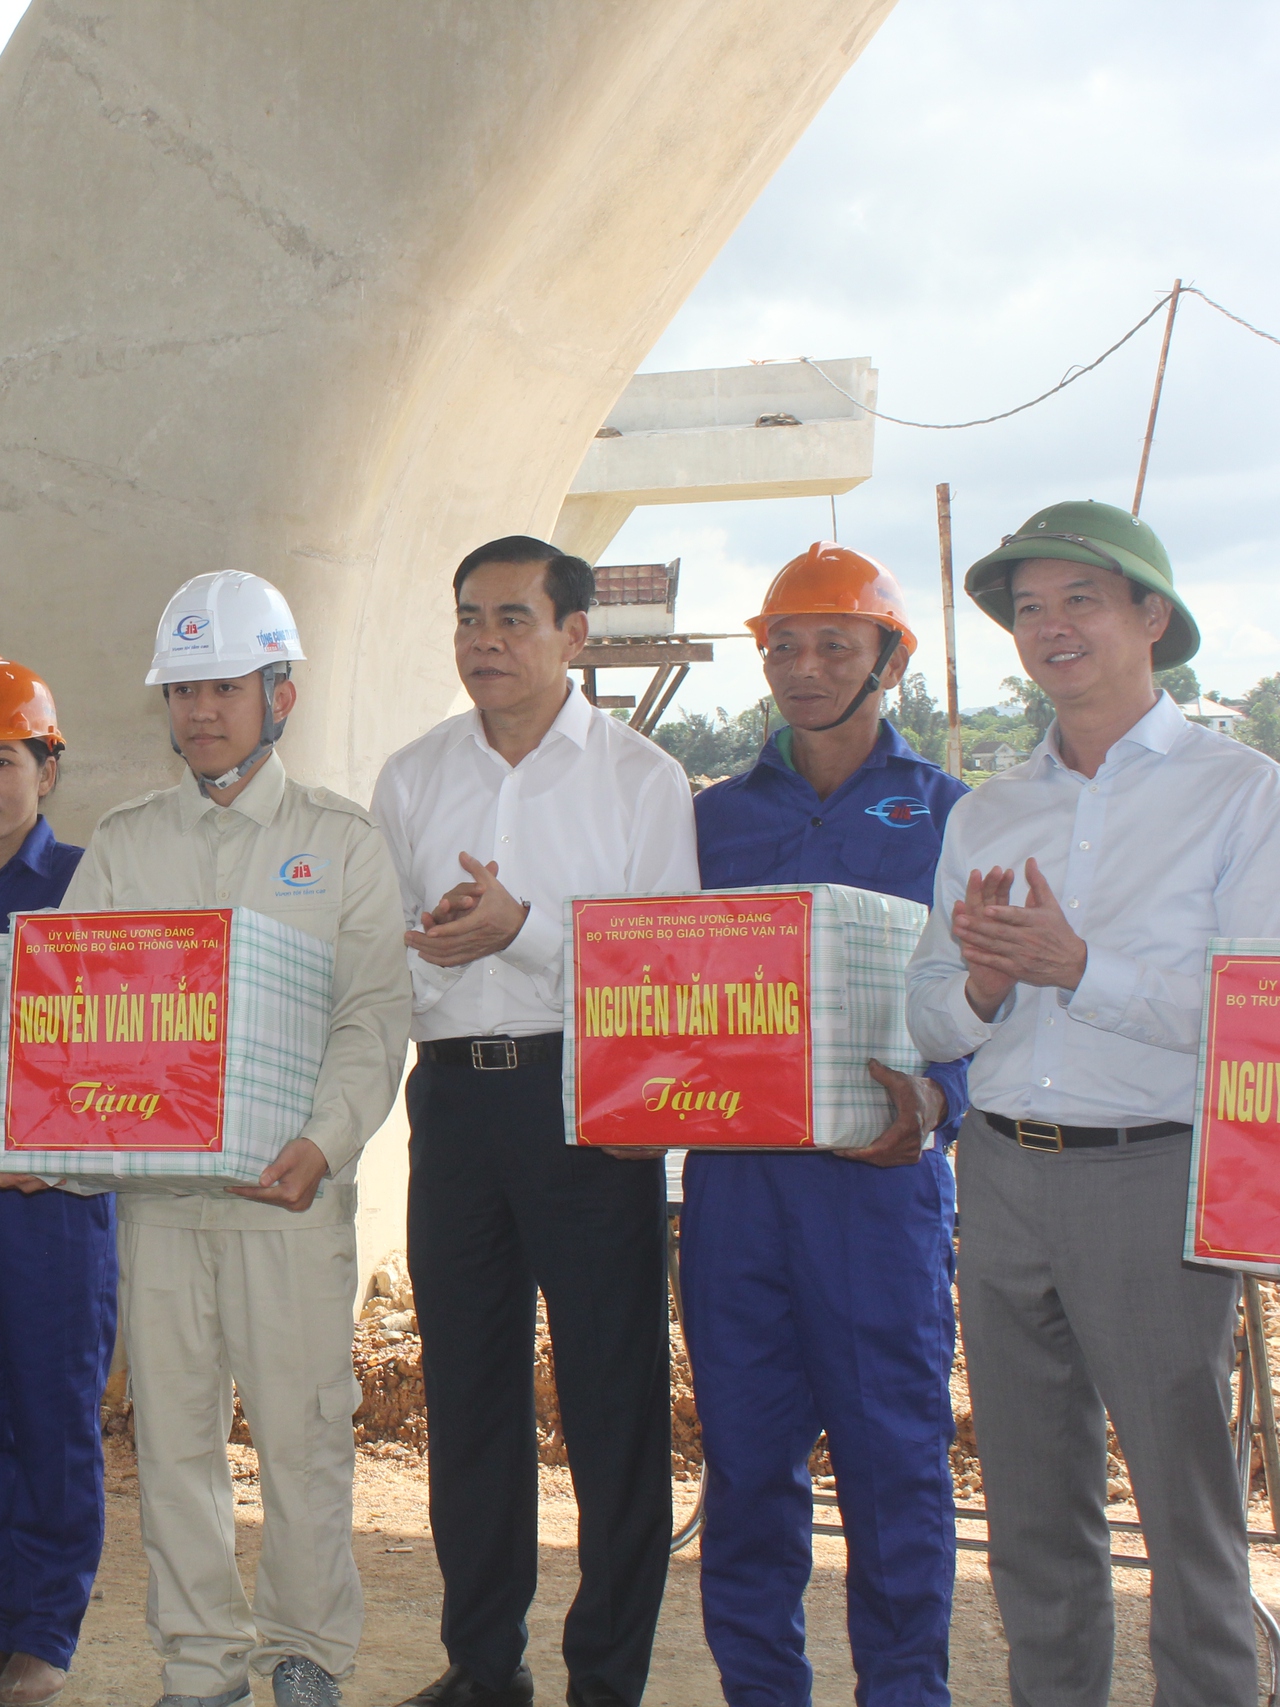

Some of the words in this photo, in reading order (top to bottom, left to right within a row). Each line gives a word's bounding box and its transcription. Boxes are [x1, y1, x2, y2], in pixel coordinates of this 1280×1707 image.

[610, 916, 626, 928] ỦY
[628, 915, 653, 927] VIÊN
[657, 916, 696, 926] TRUNG
[699, 914, 734, 925] ƯƠNG
[737, 912, 772, 924] ĐẢNG
[48, 930, 62, 941] ỦY
[65, 930, 88, 940] VIÊN
[91, 930, 127, 939] TRUNG
[130, 928, 162, 939] ƯƠNG
[164, 927, 195, 937] ĐẢNG
[586, 931, 603, 943] BỘ
[605, 929, 653, 941] TRƯỞNG
[656, 929, 673, 941] BỘ
[676, 928, 705, 939] GIAO
[708, 926, 748, 938] THÔNG
[751, 926, 776, 938] VẬN
[779, 925, 798, 936] TẢI
[26, 944, 41, 955] BỘ
[43, 942, 88, 953] TRƯỞNG
[91, 943, 106, 953] BỘ
[109, 942, 135, 951] GIAO
[138, 939, 174, 950] THÔNG
[176, 940, 199, 950] VẬN
[202, 939, 219, 949] TẢI
[1258, 976, 1278, 991] ỦY
[585, 964, 669, 1038] NGUYỄN
[675, 972, 718, 1036] VĂN
[724, 964, 800, 1035] THẮNG
[1226, 993, 1246, 1008] BỘ
[20, 975, 99, 1044] NGUYỄN
[105, 983, 144, 1043] VĂN
[151, 975, 217, 1042] THẮNG
[68, 1081, 161, 1122] Tặng
[641, 1076, 744, 1121] Tặng
